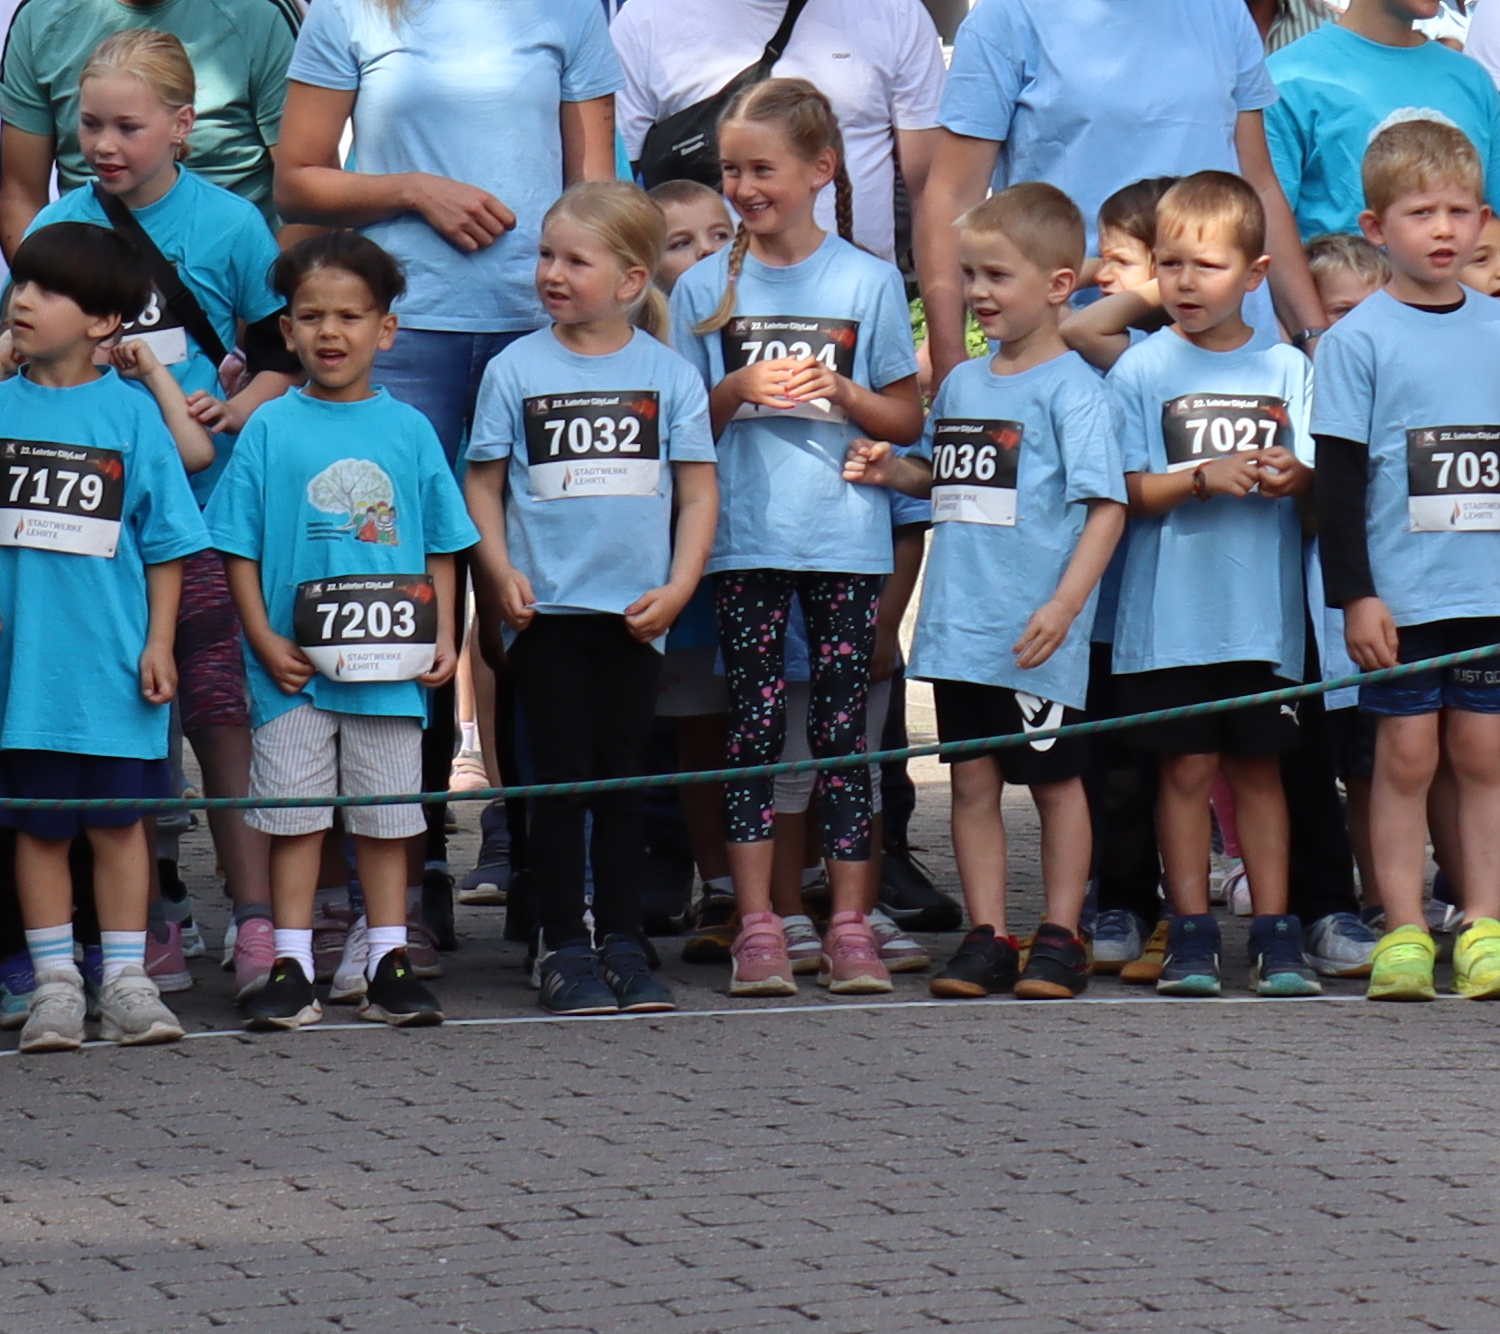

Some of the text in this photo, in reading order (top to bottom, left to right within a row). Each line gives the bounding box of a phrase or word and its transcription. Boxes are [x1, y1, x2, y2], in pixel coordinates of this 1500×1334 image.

[544, 416, 641, 456] 7032
[1185, 416, 1279, 454] 7027
[932, 444, 997, 481] 7036
[574, 468, 628, 477] STADTWERKE
[574, 477, 607, 485] LEHRTE
[8, 466, 103, 511] 7179
[1463, 511, 1493, 519] LEHRTE
[27, 518, 82, 533] STADTWERKE
[26, 528, 58, 540] LEHRTE
[316, 601, 416, 640] 7203
[347, 652, 402, 662] STADTWERKE
[347, 663, 379, 671] LEHRTE
